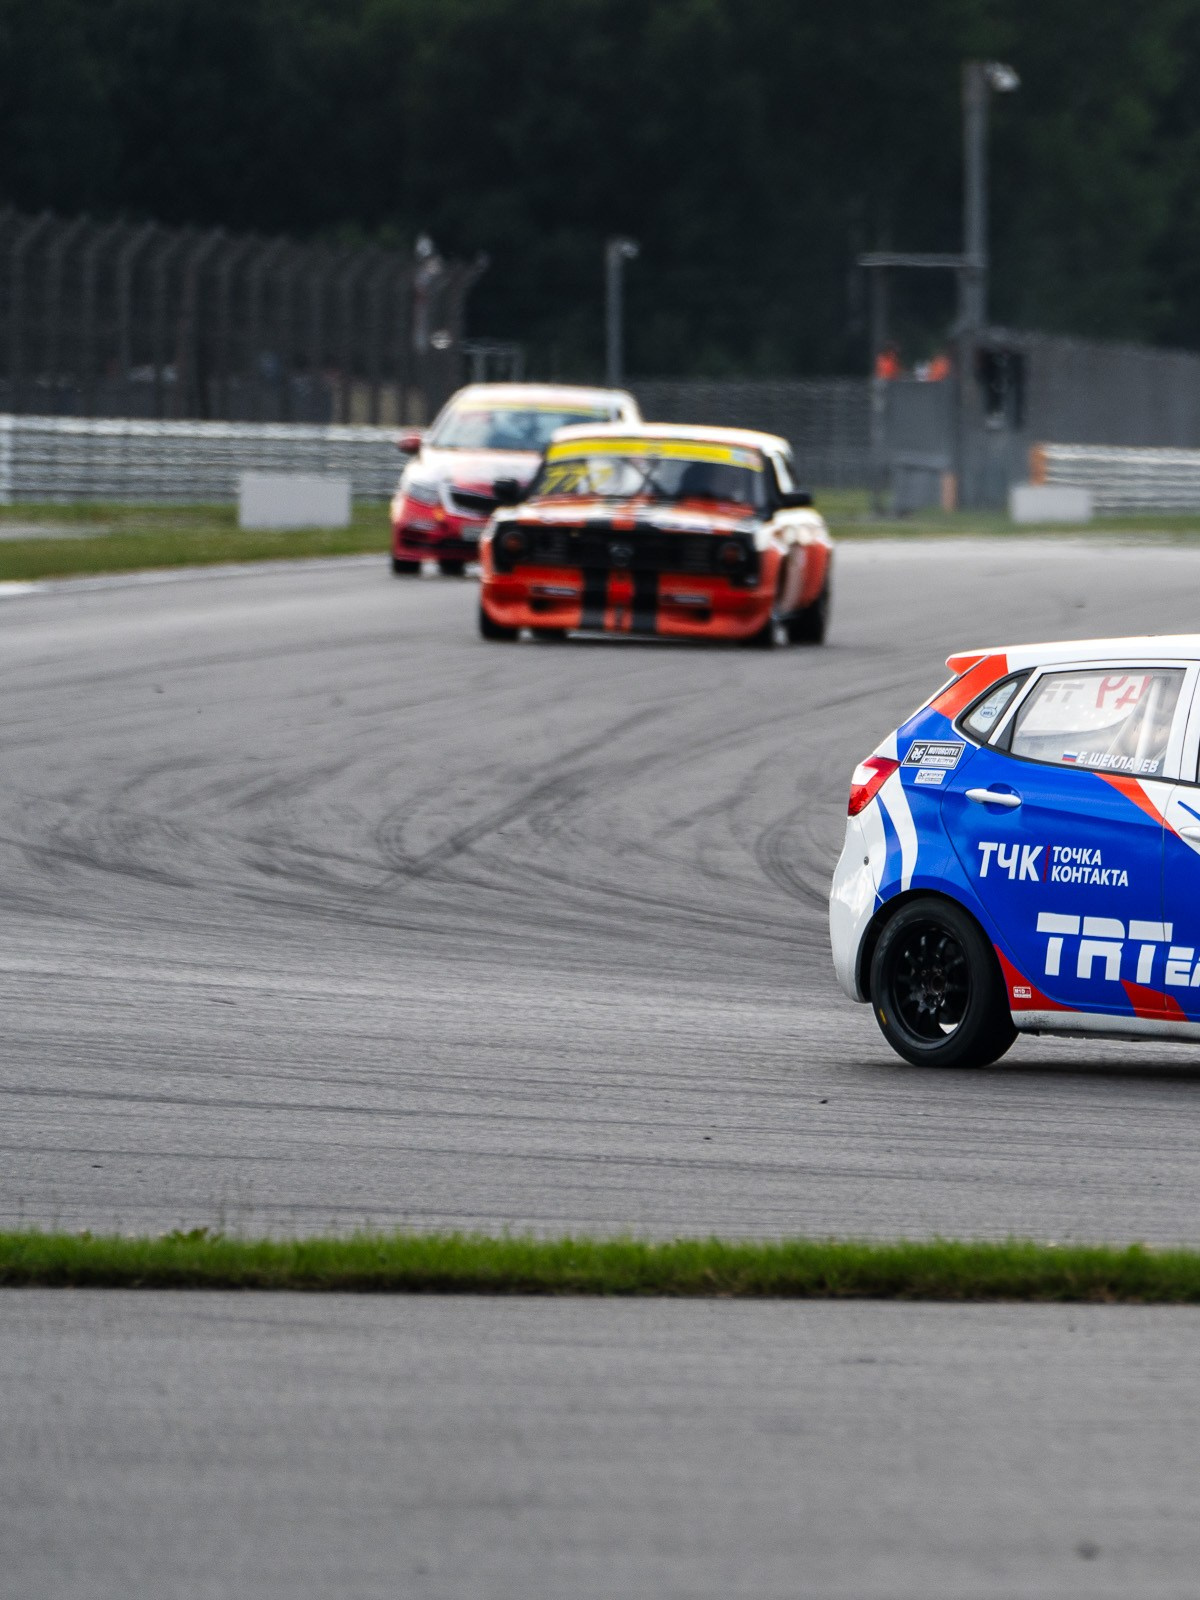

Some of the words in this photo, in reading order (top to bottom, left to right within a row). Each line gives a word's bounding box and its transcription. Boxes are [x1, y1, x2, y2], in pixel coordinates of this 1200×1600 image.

[978, 841, 1043, 882] ТЧК
[1052, 846, 1102, 866] ТОЧКА
[1051, 866, 1129, 887] КОНТАКТА
